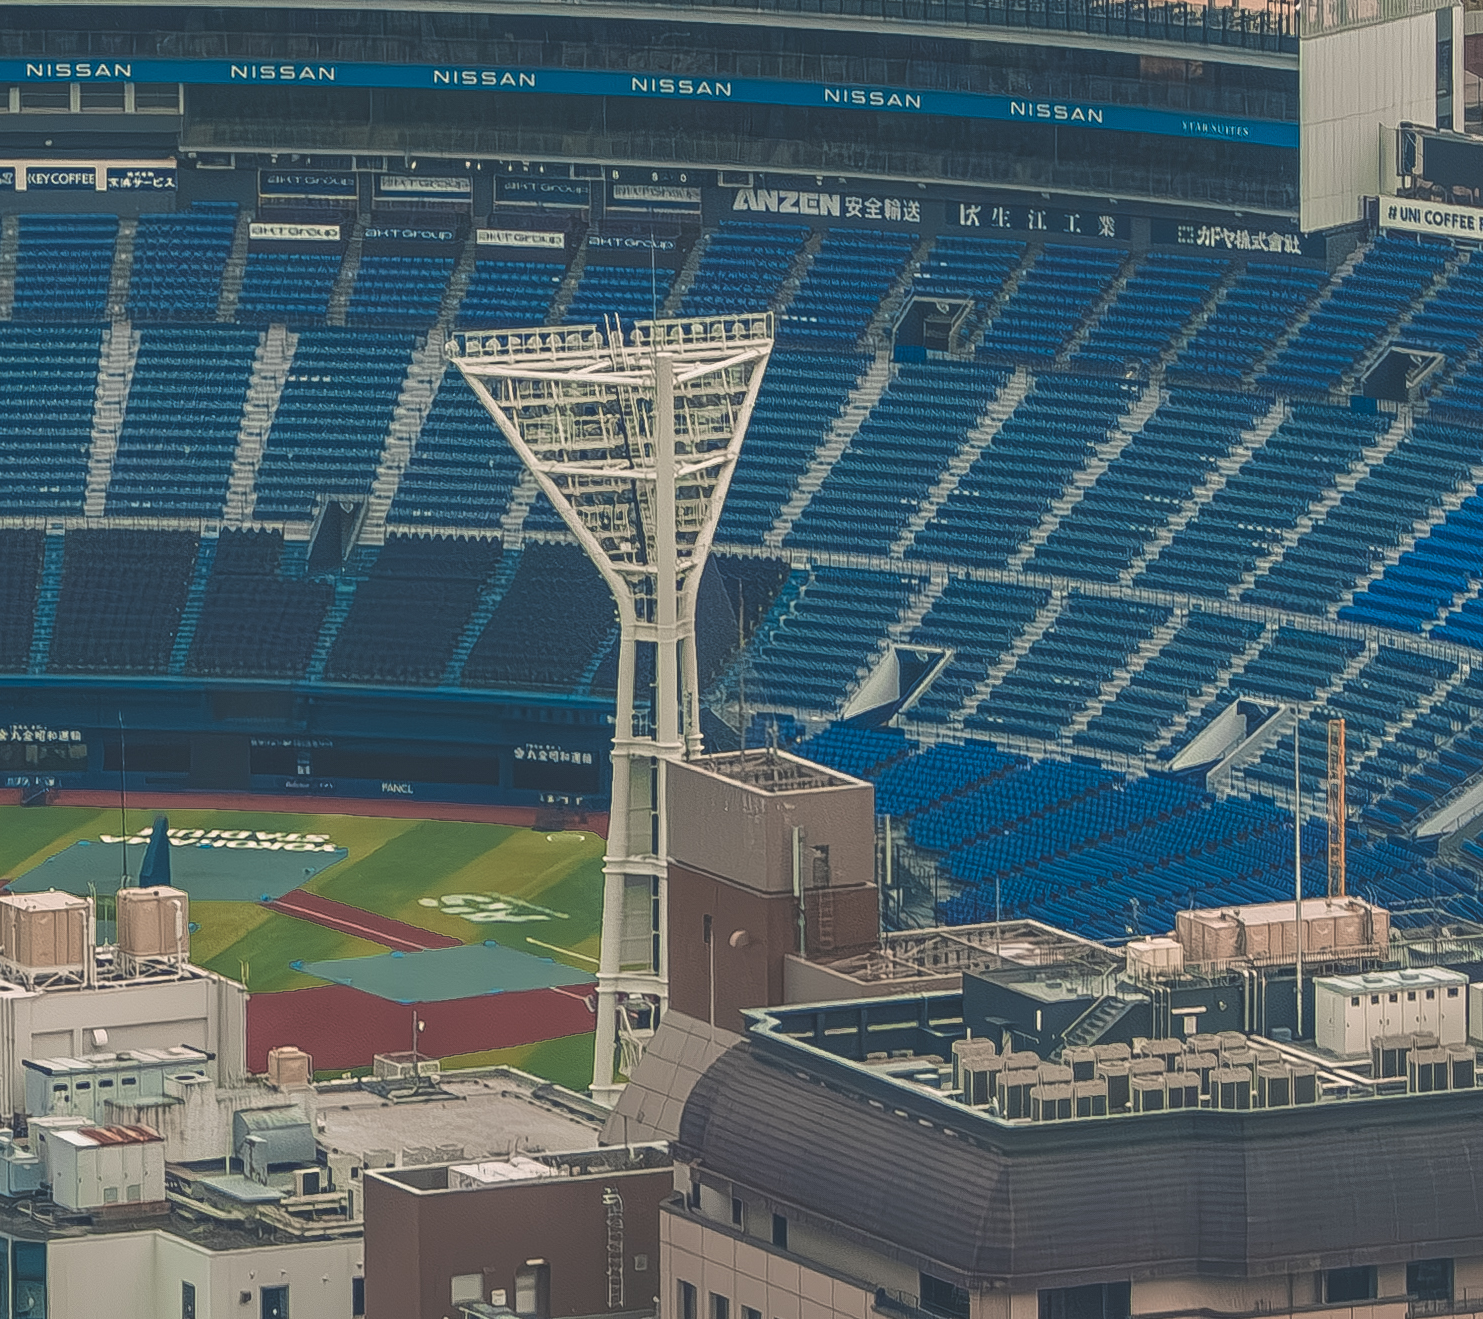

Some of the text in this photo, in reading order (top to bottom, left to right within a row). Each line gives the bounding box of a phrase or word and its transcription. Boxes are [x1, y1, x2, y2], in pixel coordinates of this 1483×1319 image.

[26, 62, 132, 79] NISSAN
[230, 64, 337, 82] NISSAN
[433, 68, 537, 88] NISSAN
[631, 77, 733, 96] NISSAN
[824, 87, 922, 109] NISSAN
[1010, 100, 1105, 125] NISSAN
[733, 189, 841, 217] ANZEN
[844, 196, 922, 223] 安全輸送
[1400, 207, 1421, 223] UNI
[1424, 210, 1476, 231] COFFEE
